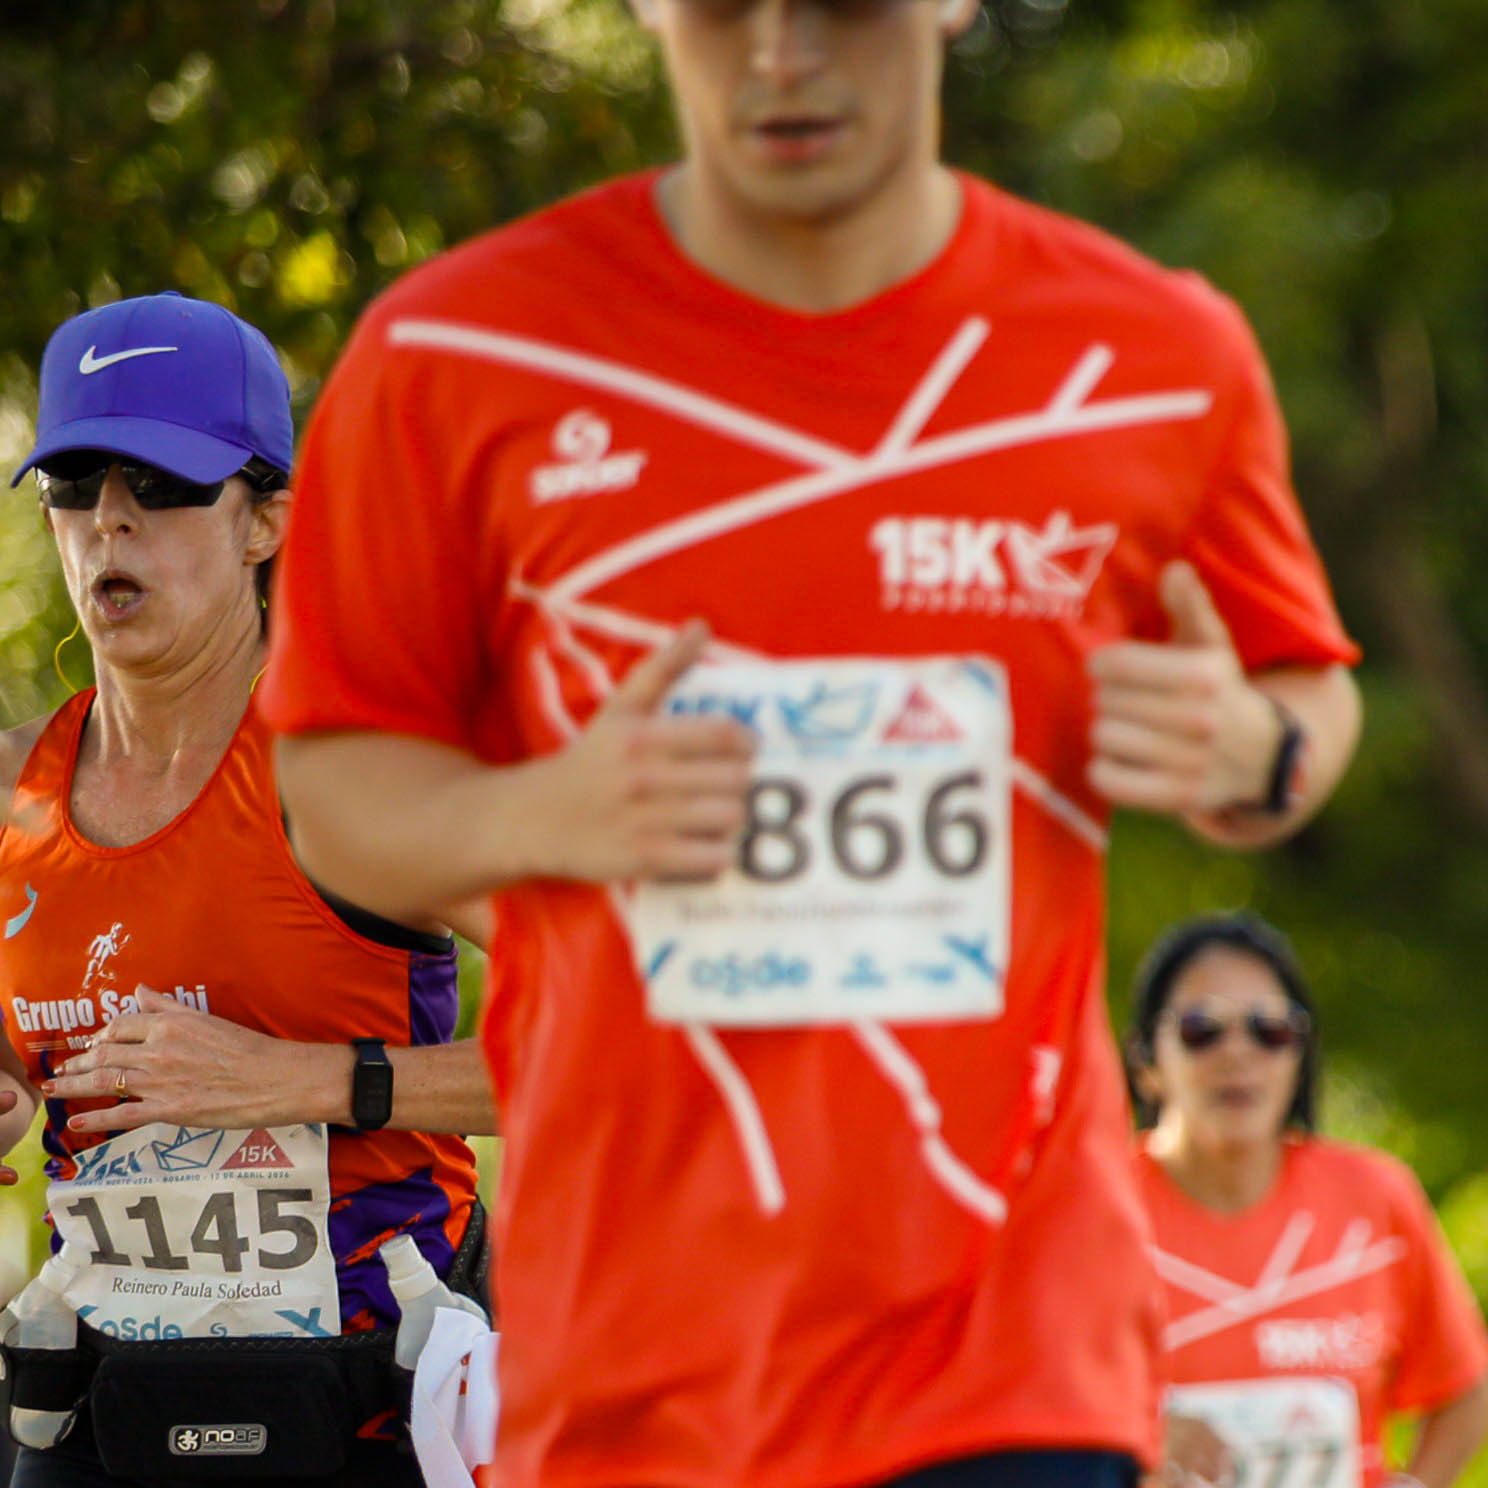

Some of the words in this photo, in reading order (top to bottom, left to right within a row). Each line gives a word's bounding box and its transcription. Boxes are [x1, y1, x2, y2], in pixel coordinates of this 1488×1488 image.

[867, 515, 1006, 586] 15K
[737, 770, 988, 882] 866
[12, 996, 96, 1032] Grupo
[101, 985, 209, 1025] Sahi
[239, 1145, 278, 1163] 15K
[67, 1189, 318, 1272] 1145
[112, 1277, 167, 1295] Reinero
[171, 1281, 213, 1298] Paula
[100, 1315, 183, 1341] osde
